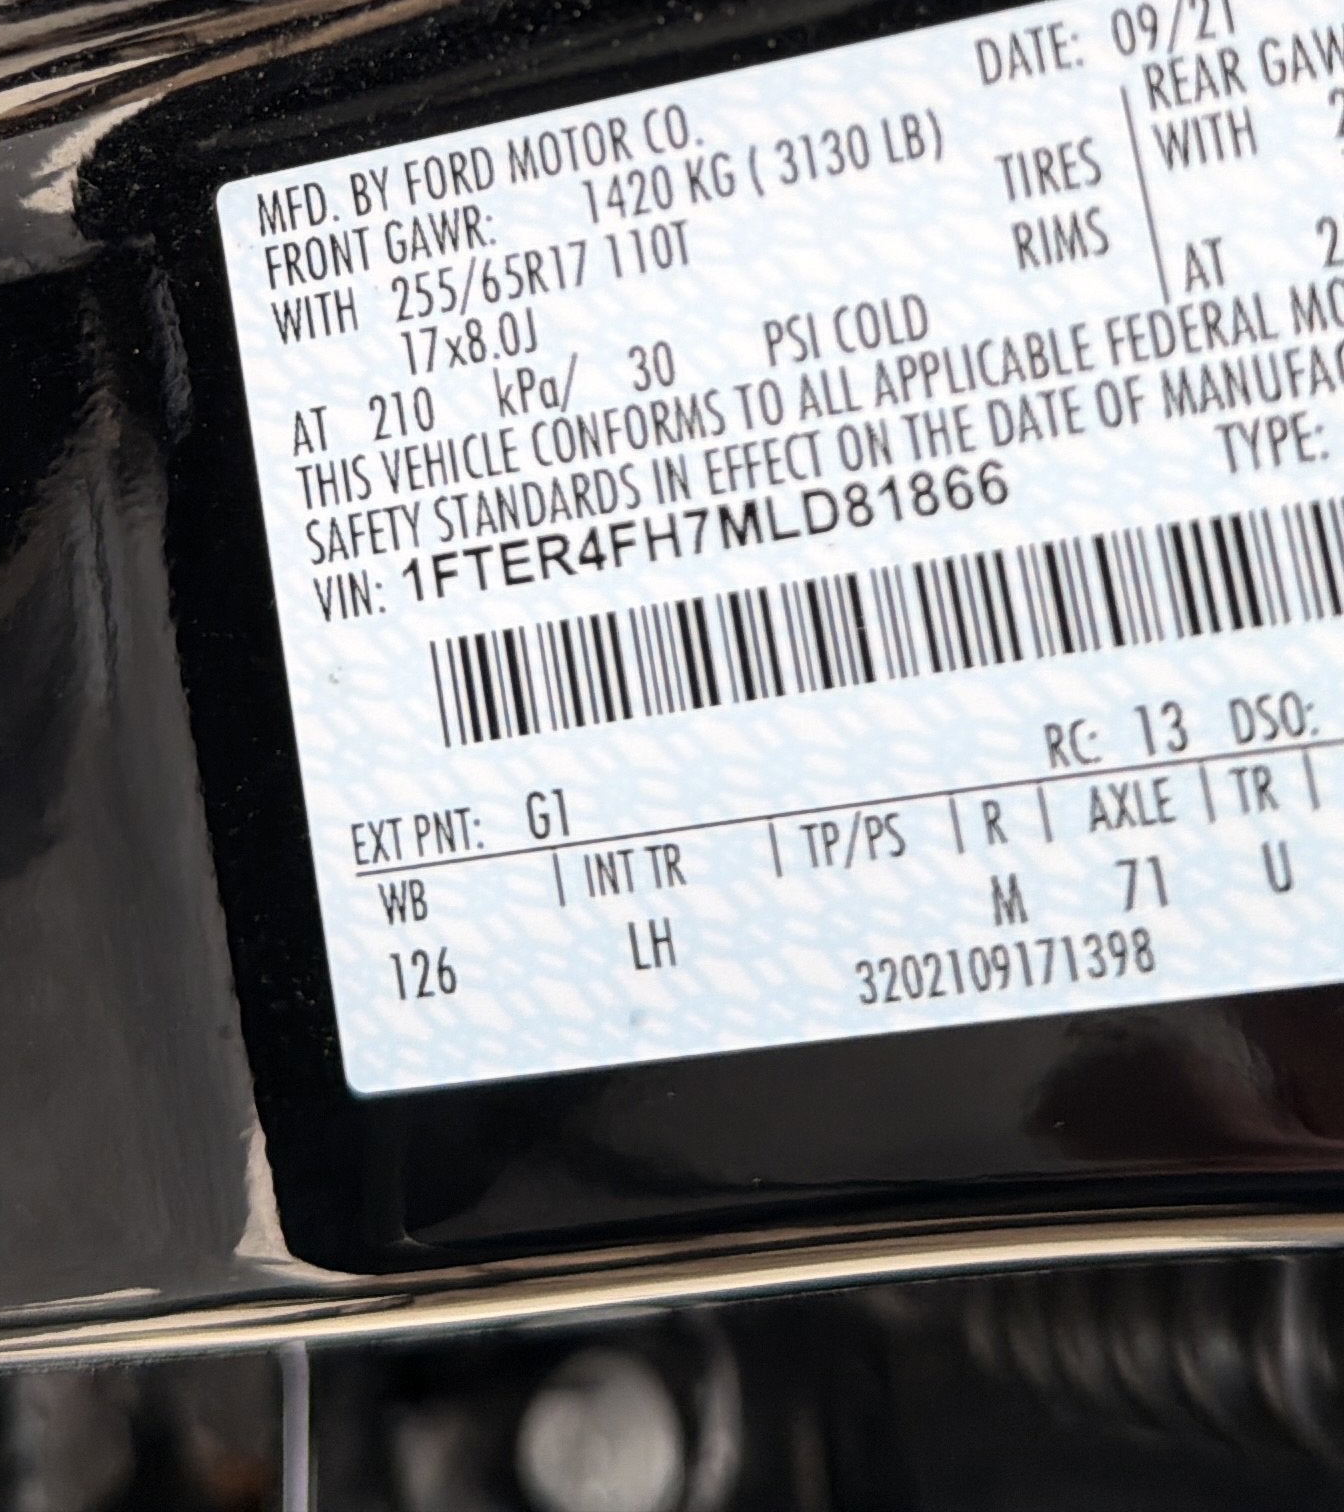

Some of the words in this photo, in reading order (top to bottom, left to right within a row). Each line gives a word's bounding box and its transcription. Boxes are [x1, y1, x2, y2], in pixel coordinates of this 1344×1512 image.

[973, 19, 1084, 86] DATE:
[1141, 45, 1247, 112] REAR
[256, 180, 340, 238] MFD.
[348, 165, 389, 217] BY
[402, 145, 495, 206] FORD
[506, 115, 634, 185] MOTOR
[641, 102, 704, 155] CO.
[995, 134, 1103, 202] TIRES
[1151, 105, 1258, 171] WITH
[263, 225, 370, 290] FRONT
[382, 203, 497, 265] GAWR:
[580, 163, 674, 224] 1420
[683, 149, 736, 204] KG
[773, 123, 871, 186] 3130
[879, 107, 943, 164] LB)
[1010, 204, 1110, 271] RIMS
[1183, 234, 1226, 294] AT
[269, 285, 359, 345] WITH
[389, 238, 587, 323] 255/65R17
[603, 218, 689, 279] 110T
[399, 305, 538, 376] 17x8.0J
[292, 404, 328, 457] AT
[367, 385, 435, 442] 210
[491, 351, 578, 418] kPa/
[626, 338, 676, 393] 30
[761, 311, 821, 368] PSI
[831, 292, 929, 355] COLD
[294, 453, 372, 510] THIS
[379, 426, 521, 494] VEHICLE
[529, 387, 727, 468] CONFORMS
[734, 377, 785, 431] TO
[798, 364, 863, 421] ALL
[874, 321, 1095, 408] APPLICABLE
[1103, 290, 1279, 367] FEDERAL
[304, 499, 421, 566] SAFETY
[432, 461, 642, 543] STANDARDS
[650, 453, 692, 505] IN
[702, 428, 823, 496] EFFECT
[835, 417, 894, 473] ON
[900, 403, 977, 462] THE
[985, 383, 1086, 448] DATE
[1093, 373, 1144, 429] OF
[1213, 409, 1330, 474] TYPE:
[311, 568, 386, 623] VIN:
[401, 459, 1009, 602] 1FTER4FH7MLD81866
[1042, 716, 1103, 769] RC:
[1132, 699, 1189, 757] 13
[1227, 690, 1320, 746] DSO:
[980, 798, 1009, 845] R
[1087, 775, 1177, 834] AXLE
[1227, 763, 1279, 814] TR
[349, 815, 403, 866] EXT
[412, 805, 485, 857] PNT:
[524, 786, 570, 841] G1
[798, 811, 907, 870] TP/PS
[582, 847, 635, 898] INT
[642, 841, 687, 889] TR
[989, 871, 1029, 927] M
[1113, 854, 1169, 913] 71
[1259, 839, 1295, 895] U
[376, 877, 429, 926] WB
[388, 945, 458, 1001] 126
[626, 916, 677, 971] LH
[853, 925, 1156, 1006] 3202109171398
